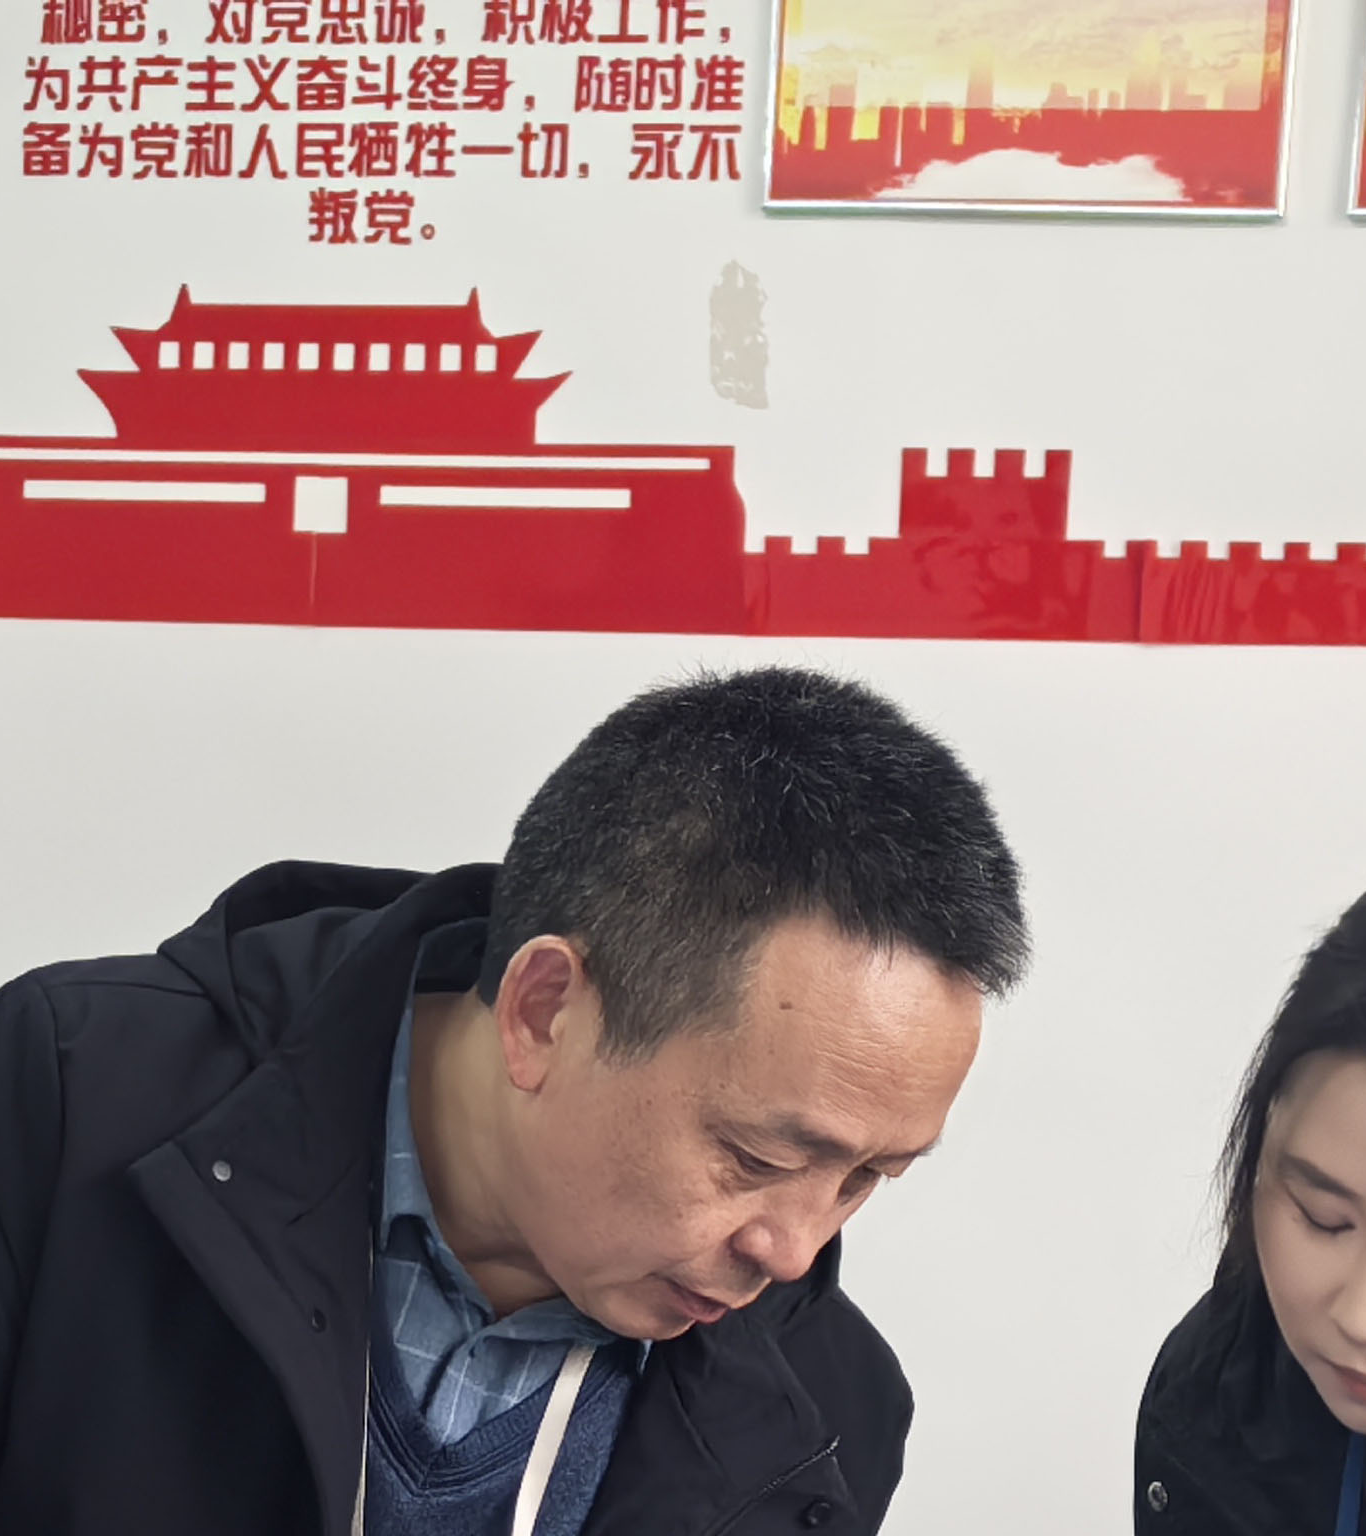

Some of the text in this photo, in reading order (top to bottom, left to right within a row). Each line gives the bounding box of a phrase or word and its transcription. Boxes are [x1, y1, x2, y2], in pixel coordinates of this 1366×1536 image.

[24, 54, 744, 113] 为共产主义奋斗终身，随时准
[23, 122, 742, 181] 备为党和人民牺牲一切，永不
[309, 189, 436, 245] 叛党。
